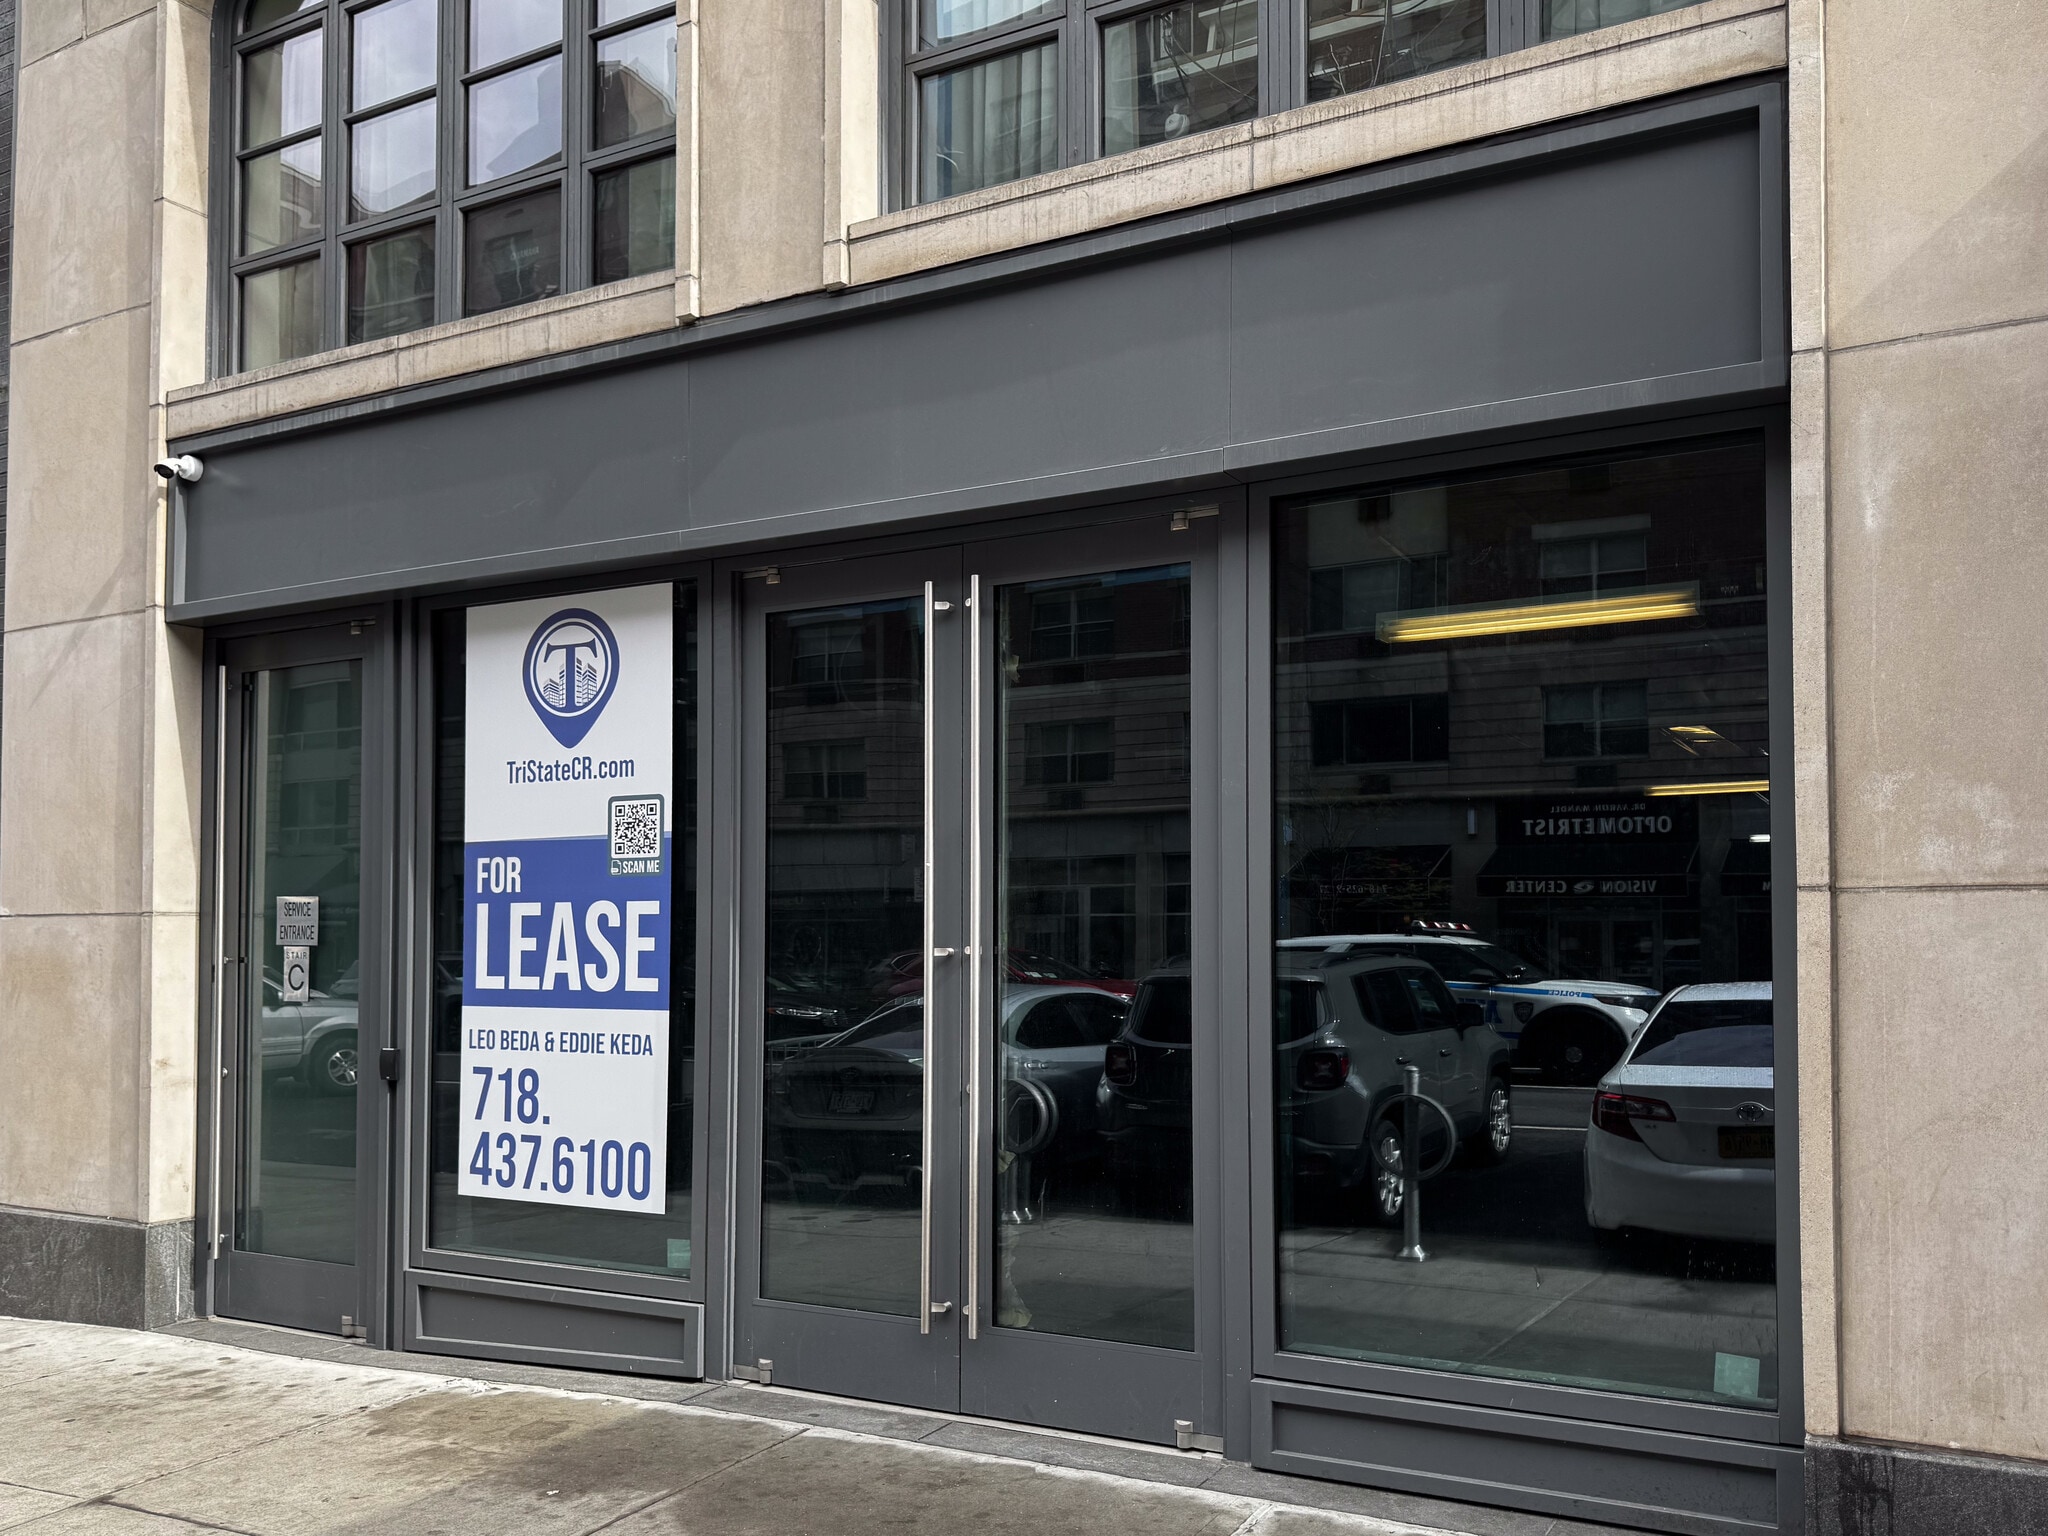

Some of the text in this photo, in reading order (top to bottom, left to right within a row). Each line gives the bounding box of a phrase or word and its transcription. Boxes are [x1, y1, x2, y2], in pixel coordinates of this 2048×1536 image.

[507, 756, 634, 784] TriStateCR.com
[476, 856, 522, 894] FOR
[622, 860, 660, 874] SCAN ME
[283, 901, 311, 917] SERVICE
[279, 924, 315, 940] ENTRANCE
[285, 951, 308, 960] STAIR
[475, 900, 660, 993] LEASE
[288, 963, 304, 991] C
[469, 1029, 653, 1056] LEO BEDA & EDDIE KEDA
[472, 1066, 550, 1125] 718.
[469, 1131, 651, 1201] 437.6100
